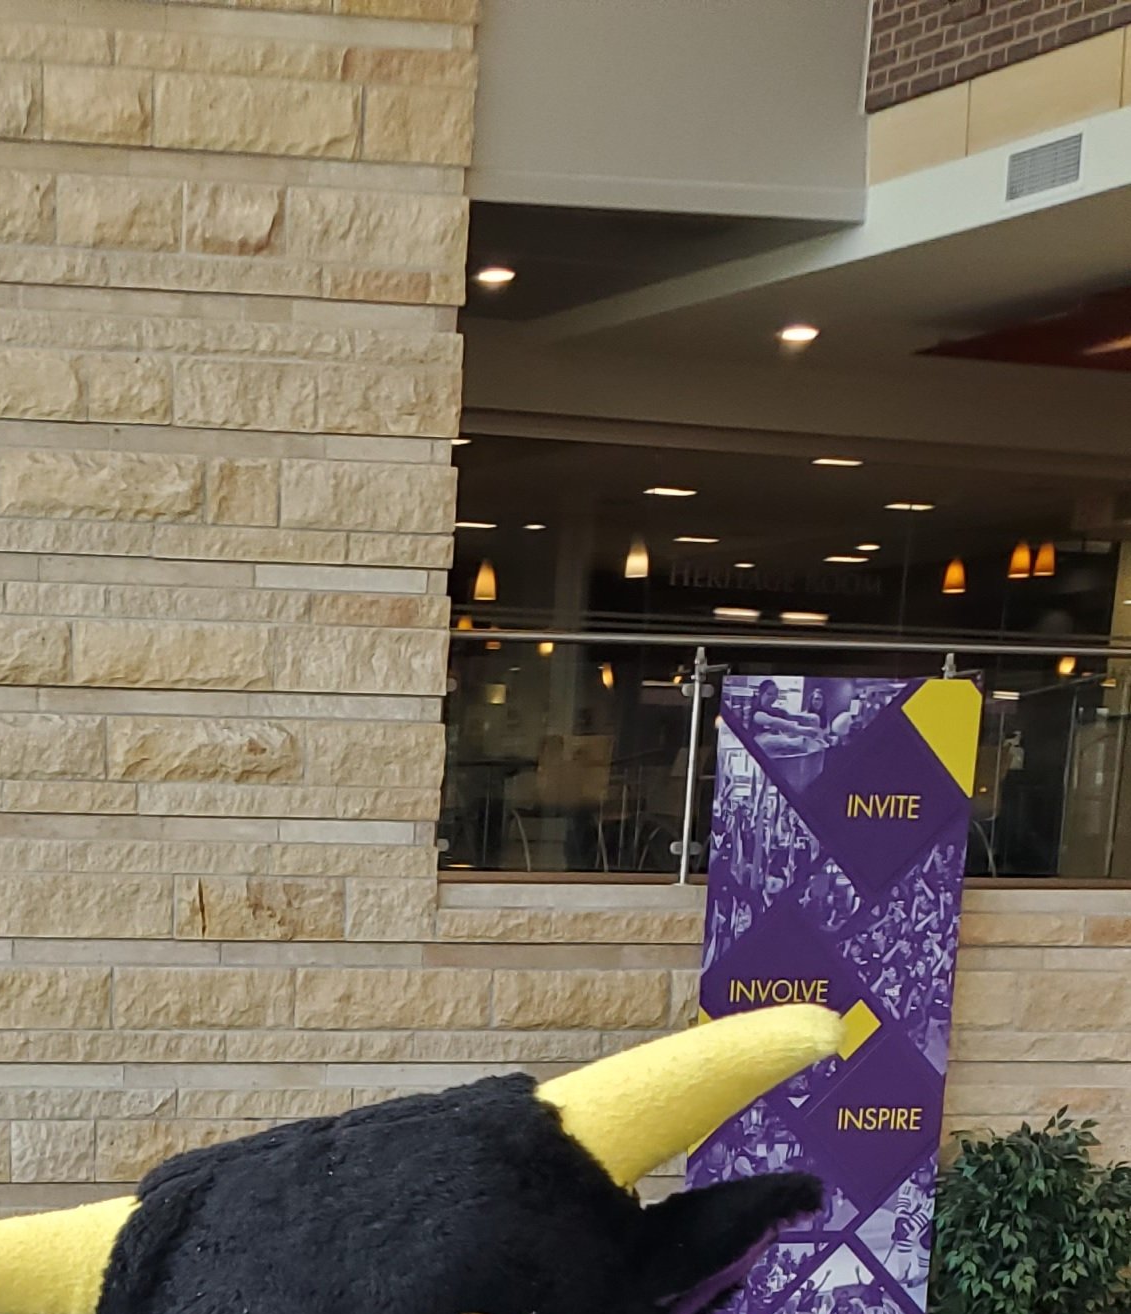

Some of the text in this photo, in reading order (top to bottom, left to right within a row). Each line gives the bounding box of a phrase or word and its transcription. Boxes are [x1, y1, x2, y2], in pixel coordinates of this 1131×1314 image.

[847, 793, 921, 819] INVITE
[729, 979, 830, 1003] INVOLVE
[837, 1107, 923, 1131] INSPIRE
